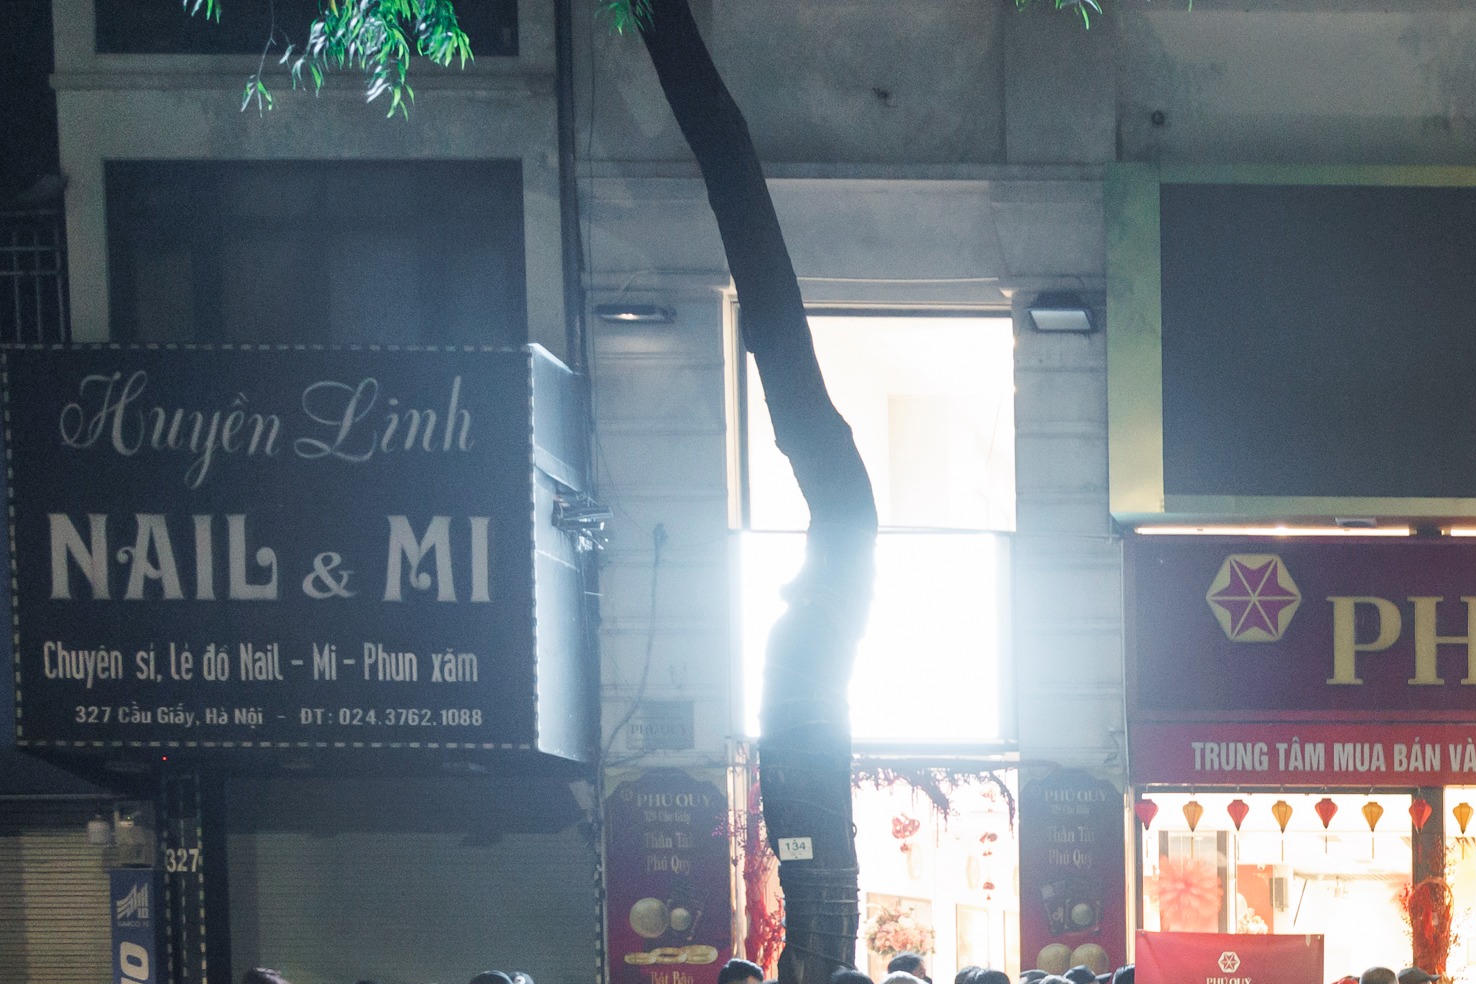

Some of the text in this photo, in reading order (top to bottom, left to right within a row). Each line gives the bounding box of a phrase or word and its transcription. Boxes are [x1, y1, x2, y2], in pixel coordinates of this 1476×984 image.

[294, 375, 475, 462] Linh
[48, 512, 492, 602] NAIL & MI
[43, 640, 123, 689] Chuyên
[239, 642, 284, 681] Nail
[313, 642, 337, 681] Mi
[363, 642, 418, 682] Phun
[431, 647, 478, 683] xăm
[75, 706, 111, 724] 327
[118, 701, 151, 725] Cầu
[205, 706, 228, 725] Hà
[234, 707, 264, 729] Nội
[1192, 742, 1269, 771] TRUNG
[1276, 736, 1325, 772] TÂM
[1333, 743, 1386, 772] MUA
[1393, 737, 1441, 773] BÁN
[166, 848, 200, 873] 327
